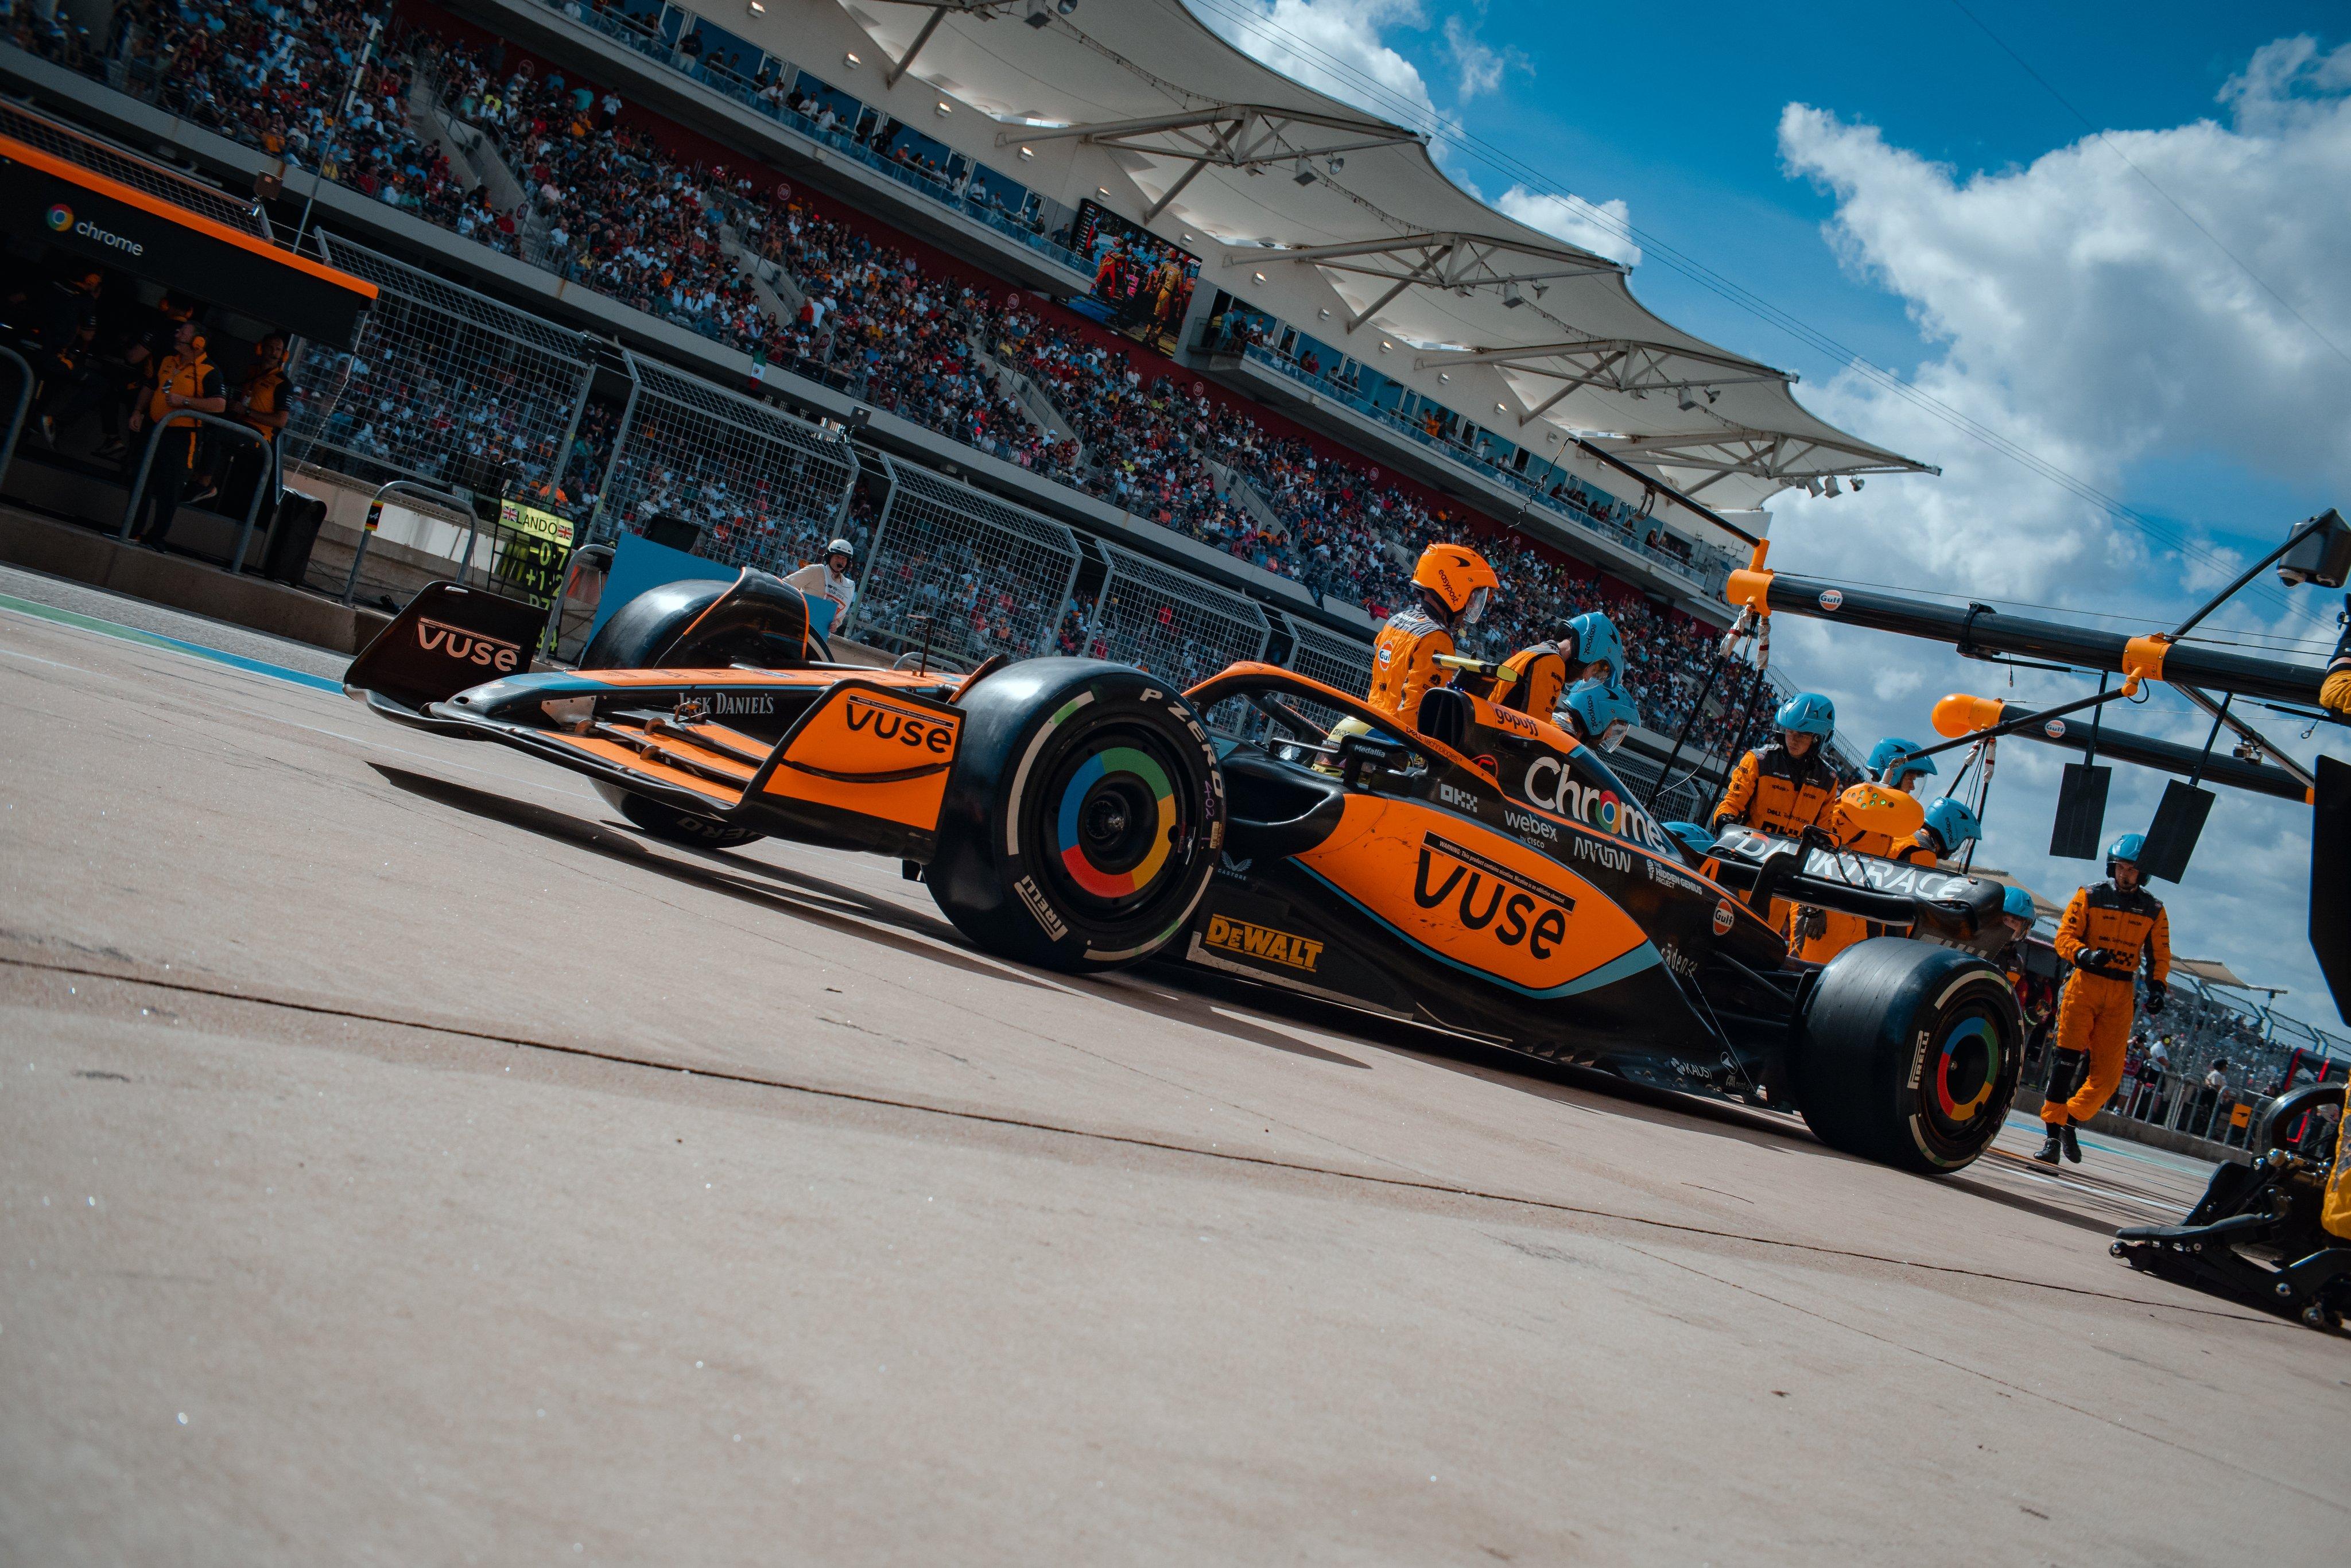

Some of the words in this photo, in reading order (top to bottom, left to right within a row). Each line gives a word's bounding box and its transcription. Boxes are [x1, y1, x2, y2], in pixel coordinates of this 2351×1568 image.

[76, 220, 143, 256] chrome
[517, 511, 558, 535] LANDO
[1820, 595, 1841, 604] Gulf
[1379, 650, 1391, 662] Gul
[1406, 726, 1422, 741] DELL
[1495, 708, 1539, 736] gopuff
[2046, 724, 2064, 733] Gulf
[1139, 688, 1163, 702] P
[1167, 701, 1224, 798] ZERO
[1354, 744, 1386, 758] Medallia
[1441, 783, 1477, 813] OKX
[1524, 756, 1666, 853] Chrome
[1767, 808, 1782, 817] DELL
[1504, 810, 1558, 843] webex
[1218, 868, 1247, 880] CASTORE
[1440, 840, 1461, 855] WARNING:
[1461, 851, 1469, 860] This
[1469, 853, 1484, 867] product
[1484, 860, 1499, 872] contains
[1514, 872, 1528, 886] Nicotine
[1536, 884, 1550, 896] addictive
[1653, 860, 1663, 870] THE
[1655, 867, 1680, 885] HIDDEN
[1679, 878, 1702, 895] GENIUS
[1655, 876, 1675, 889] PROJECT
[1014, 874, 1068, 942] PIRELLI
[1715, 909, 1733, 925] Gulf
[1907, 1030, 1930, 1089] PIRELLI
